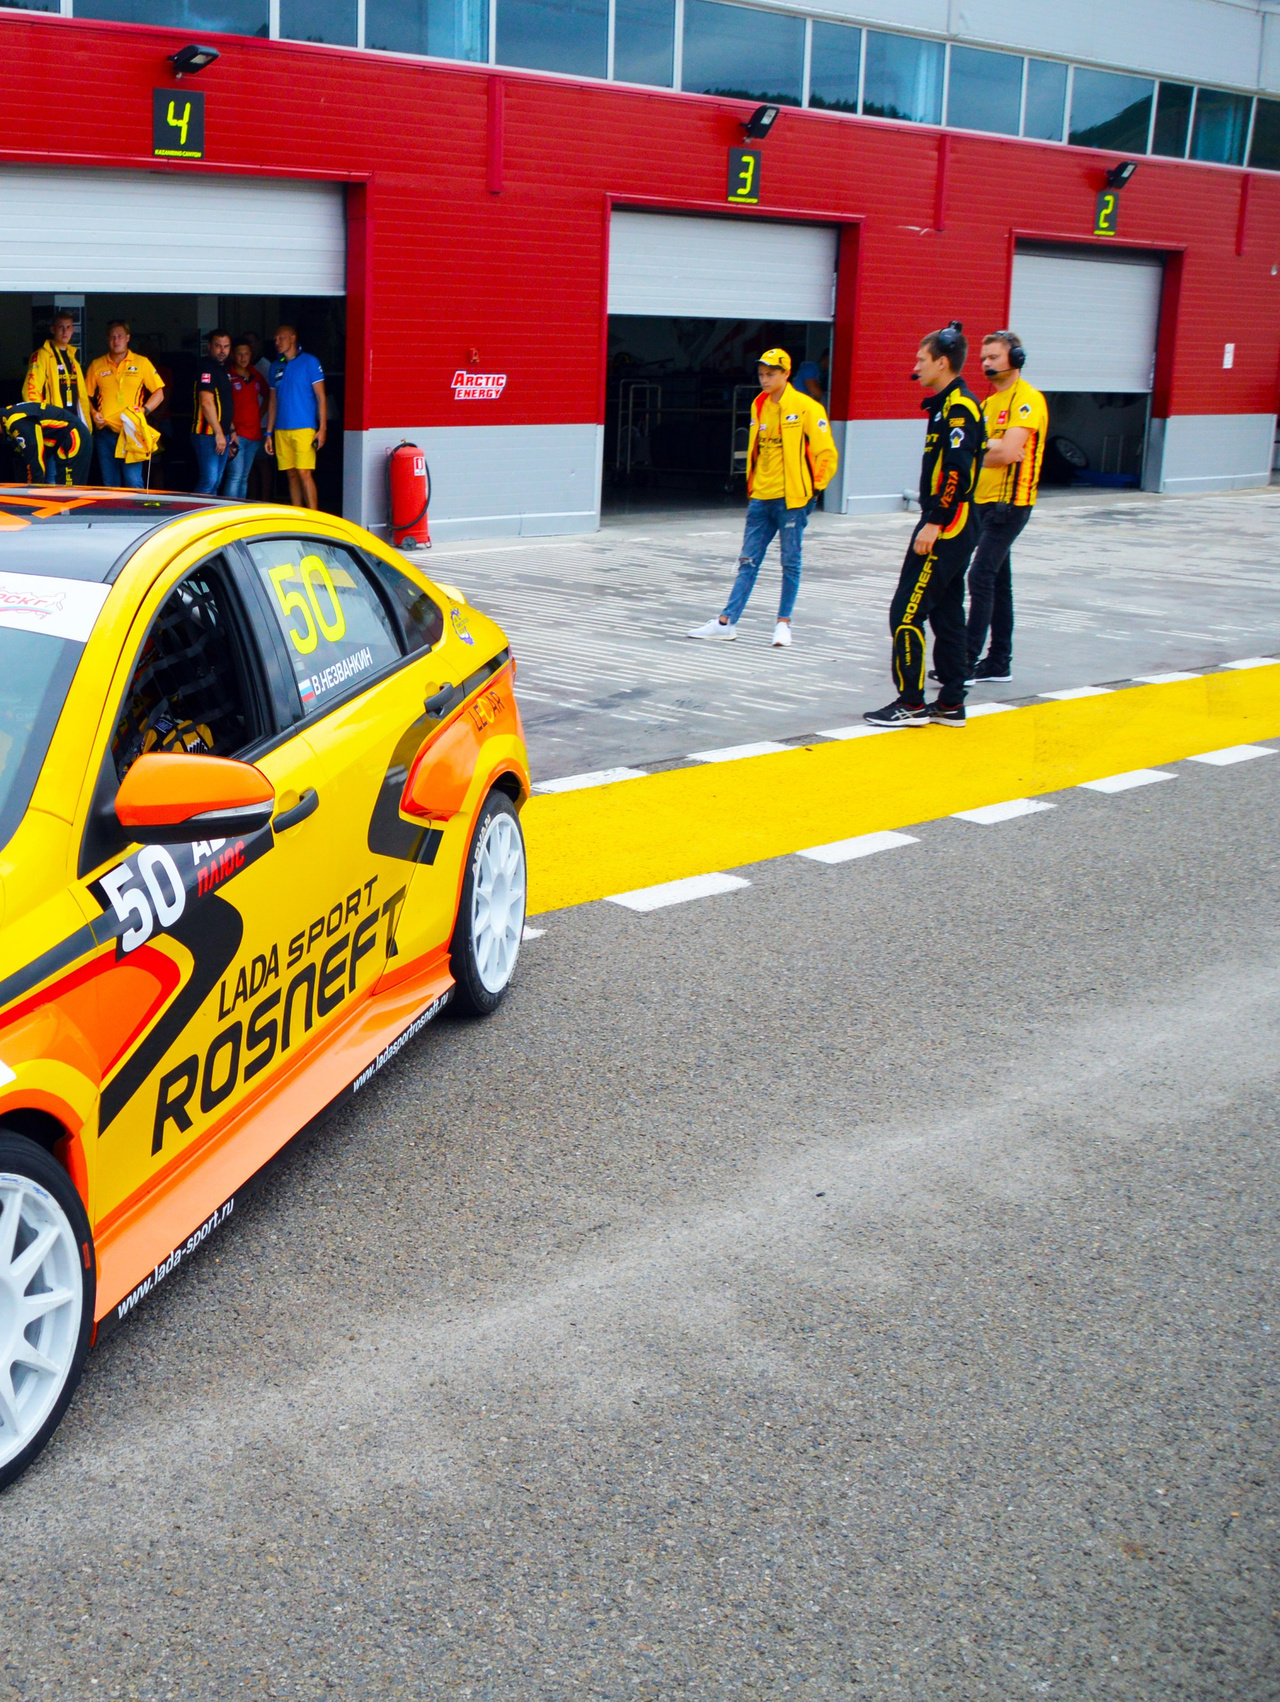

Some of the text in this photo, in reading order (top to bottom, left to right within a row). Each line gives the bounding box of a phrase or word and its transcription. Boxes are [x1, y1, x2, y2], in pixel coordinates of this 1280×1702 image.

[167, 100, 191, 145] 4
[736, 155, 755, 195] 3
[1099, 195, 1114, 228] 2
[455, 387, 502, 399] ENERGY
[940, 470, 959, 508] VESTA
[268, 554, 346, 655] 50
[902, 551, 938, 624] ROSNEFT
[311, 646, 373, 696] В.НЕЗВАНКИН
[197, 840, 246, 898] ПЛЮС
[99, 844, 187, 953] 50
[218, 874, 378, 1023] LADA SPORT
[151, 884, 408, 1157] ROSNEFT
[117, 1198, 235, 1319] www.lada-sport.ru
